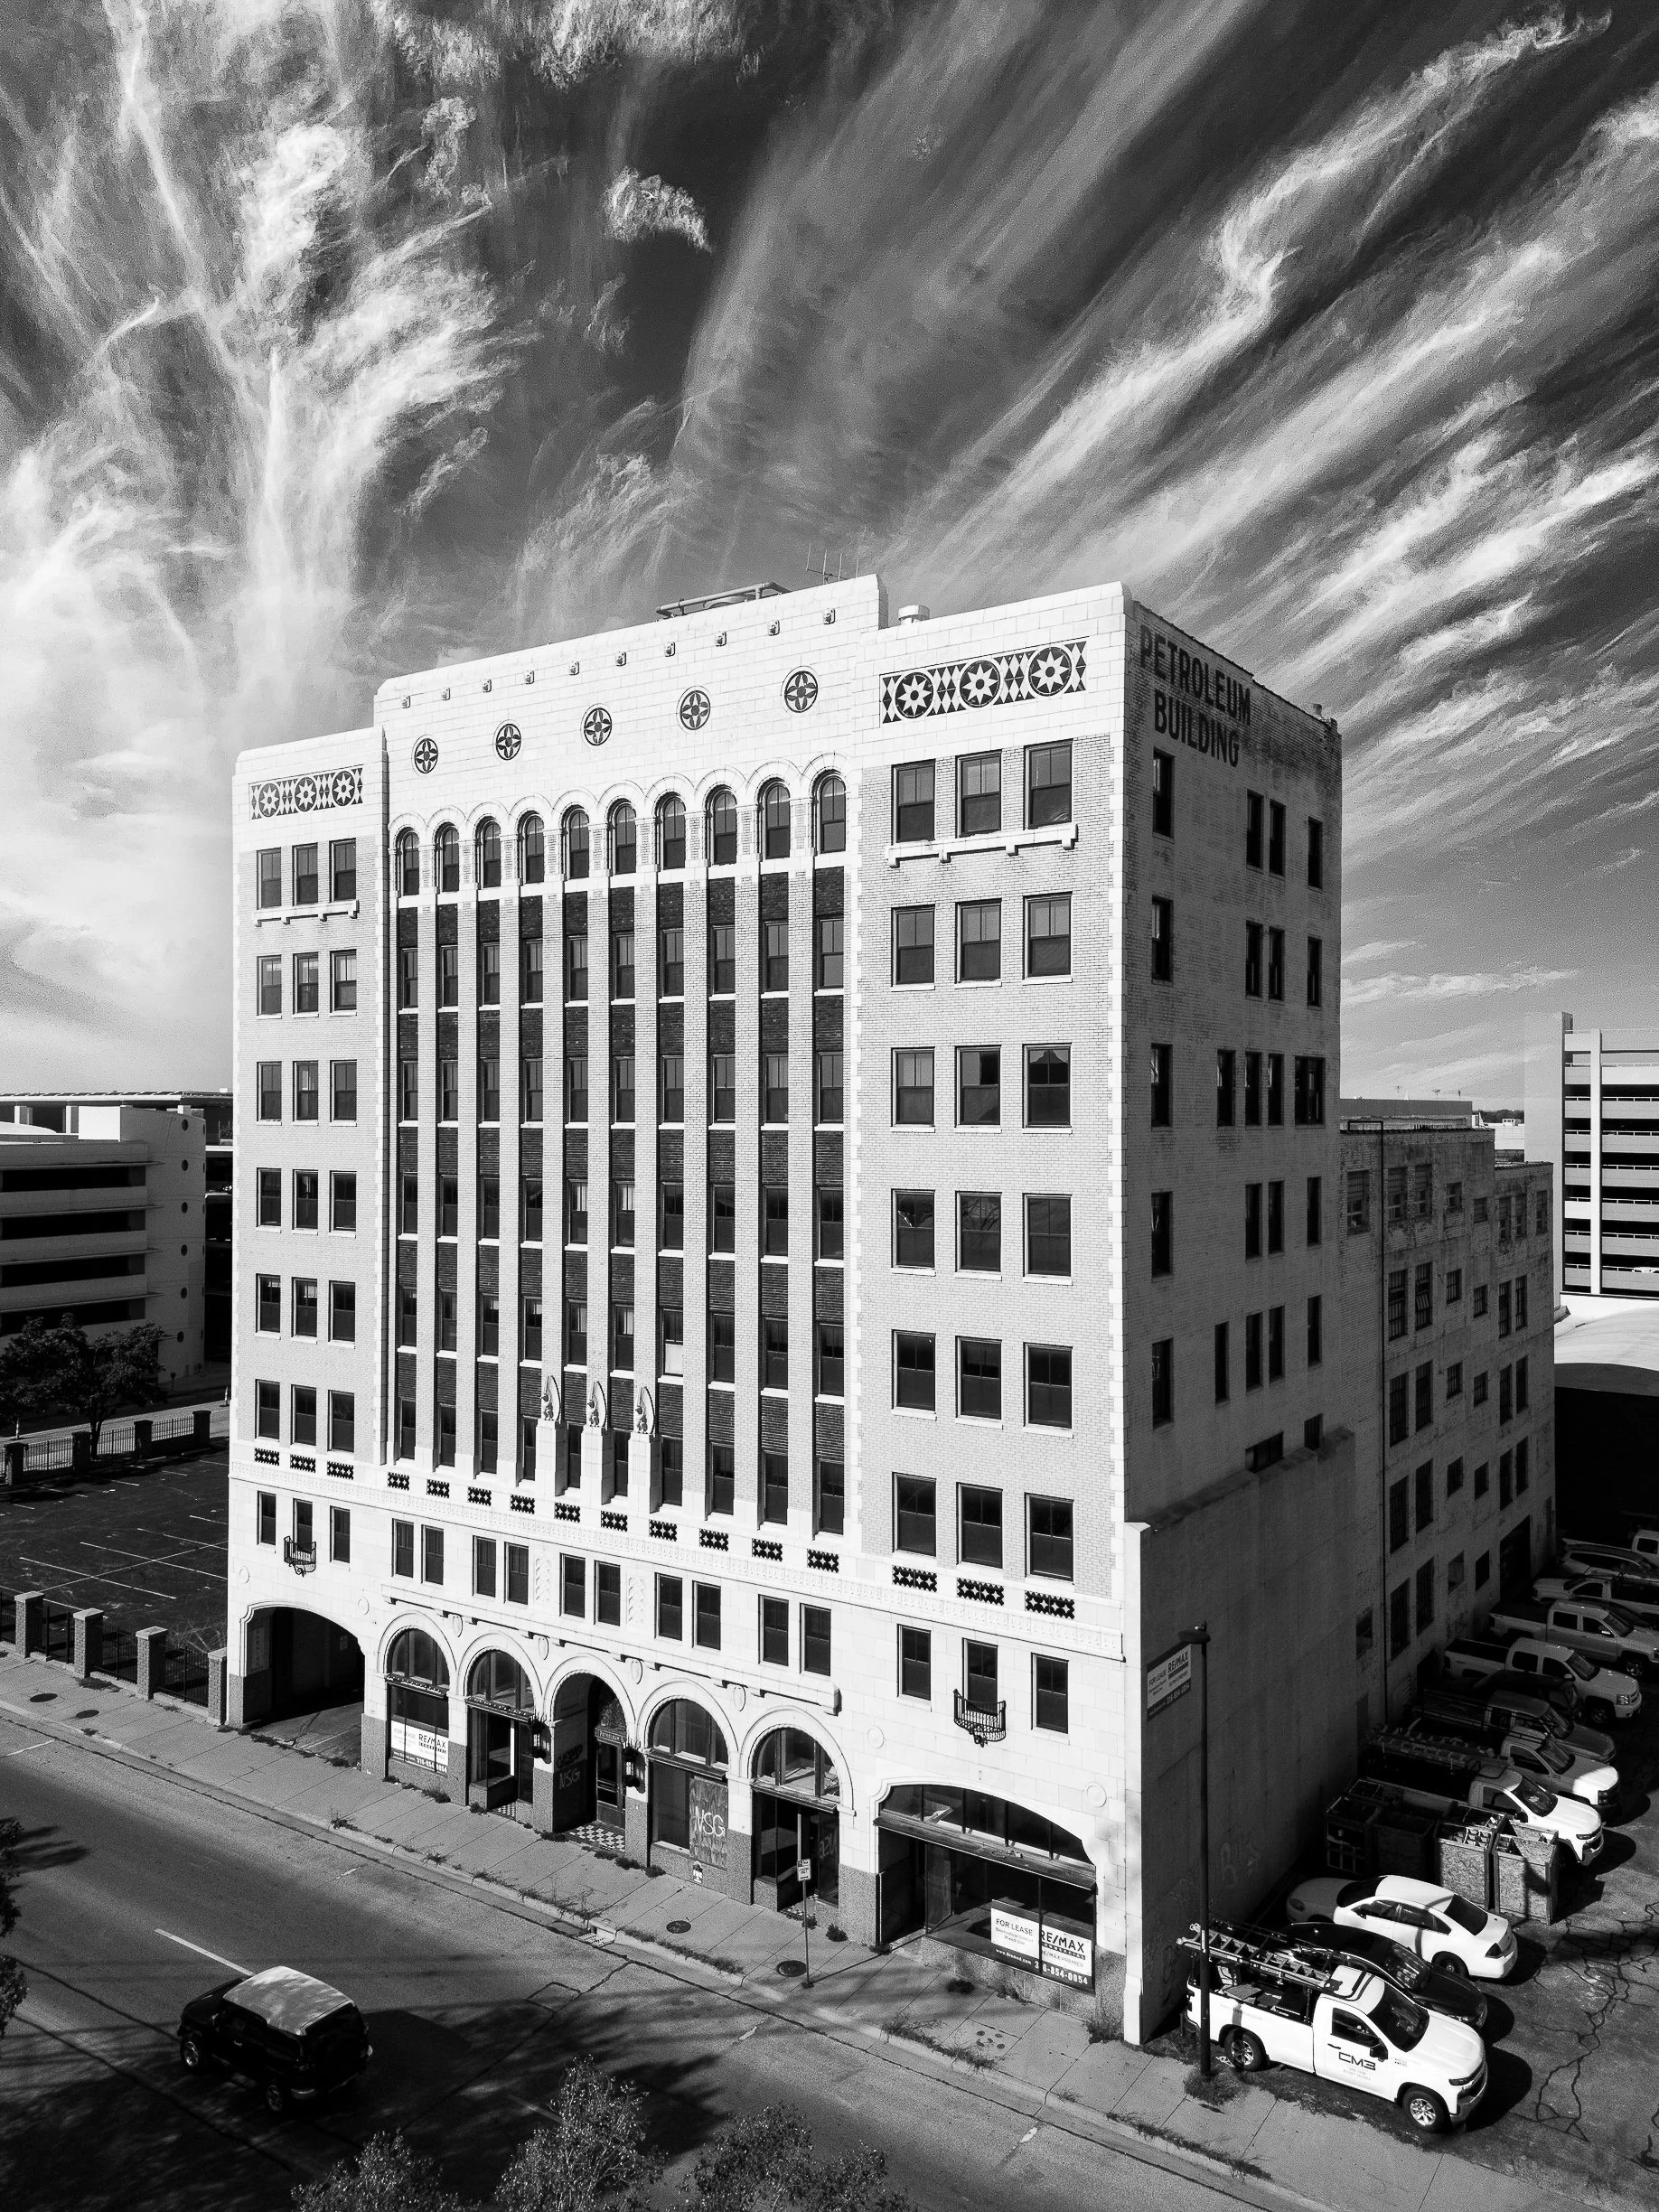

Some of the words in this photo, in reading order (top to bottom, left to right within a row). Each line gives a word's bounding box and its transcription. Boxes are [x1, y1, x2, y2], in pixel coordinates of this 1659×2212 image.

[1139, 623, 1251, 726] PETROLEUM
[1154, 689, 1240, 768] BUILDING
[1168, 1651, 1188, 1673] RE/MAX
[418, 1733, 445, 1748] RE/MAX
[996, 1917, 1009, 1928] FOR
[1011, 1923, 1033, 1936] LEASE
[1041, 1930, 1083, 1954] RE/MAX
[1042, 1943, 1085, 1960] OMMERCIAL
[1043, 1950, 1060, 1959] E/MAX
[1035, 1960, 1088, 1985] 36-854-0054
[1338, 2051, 1376, 2071] CM3
